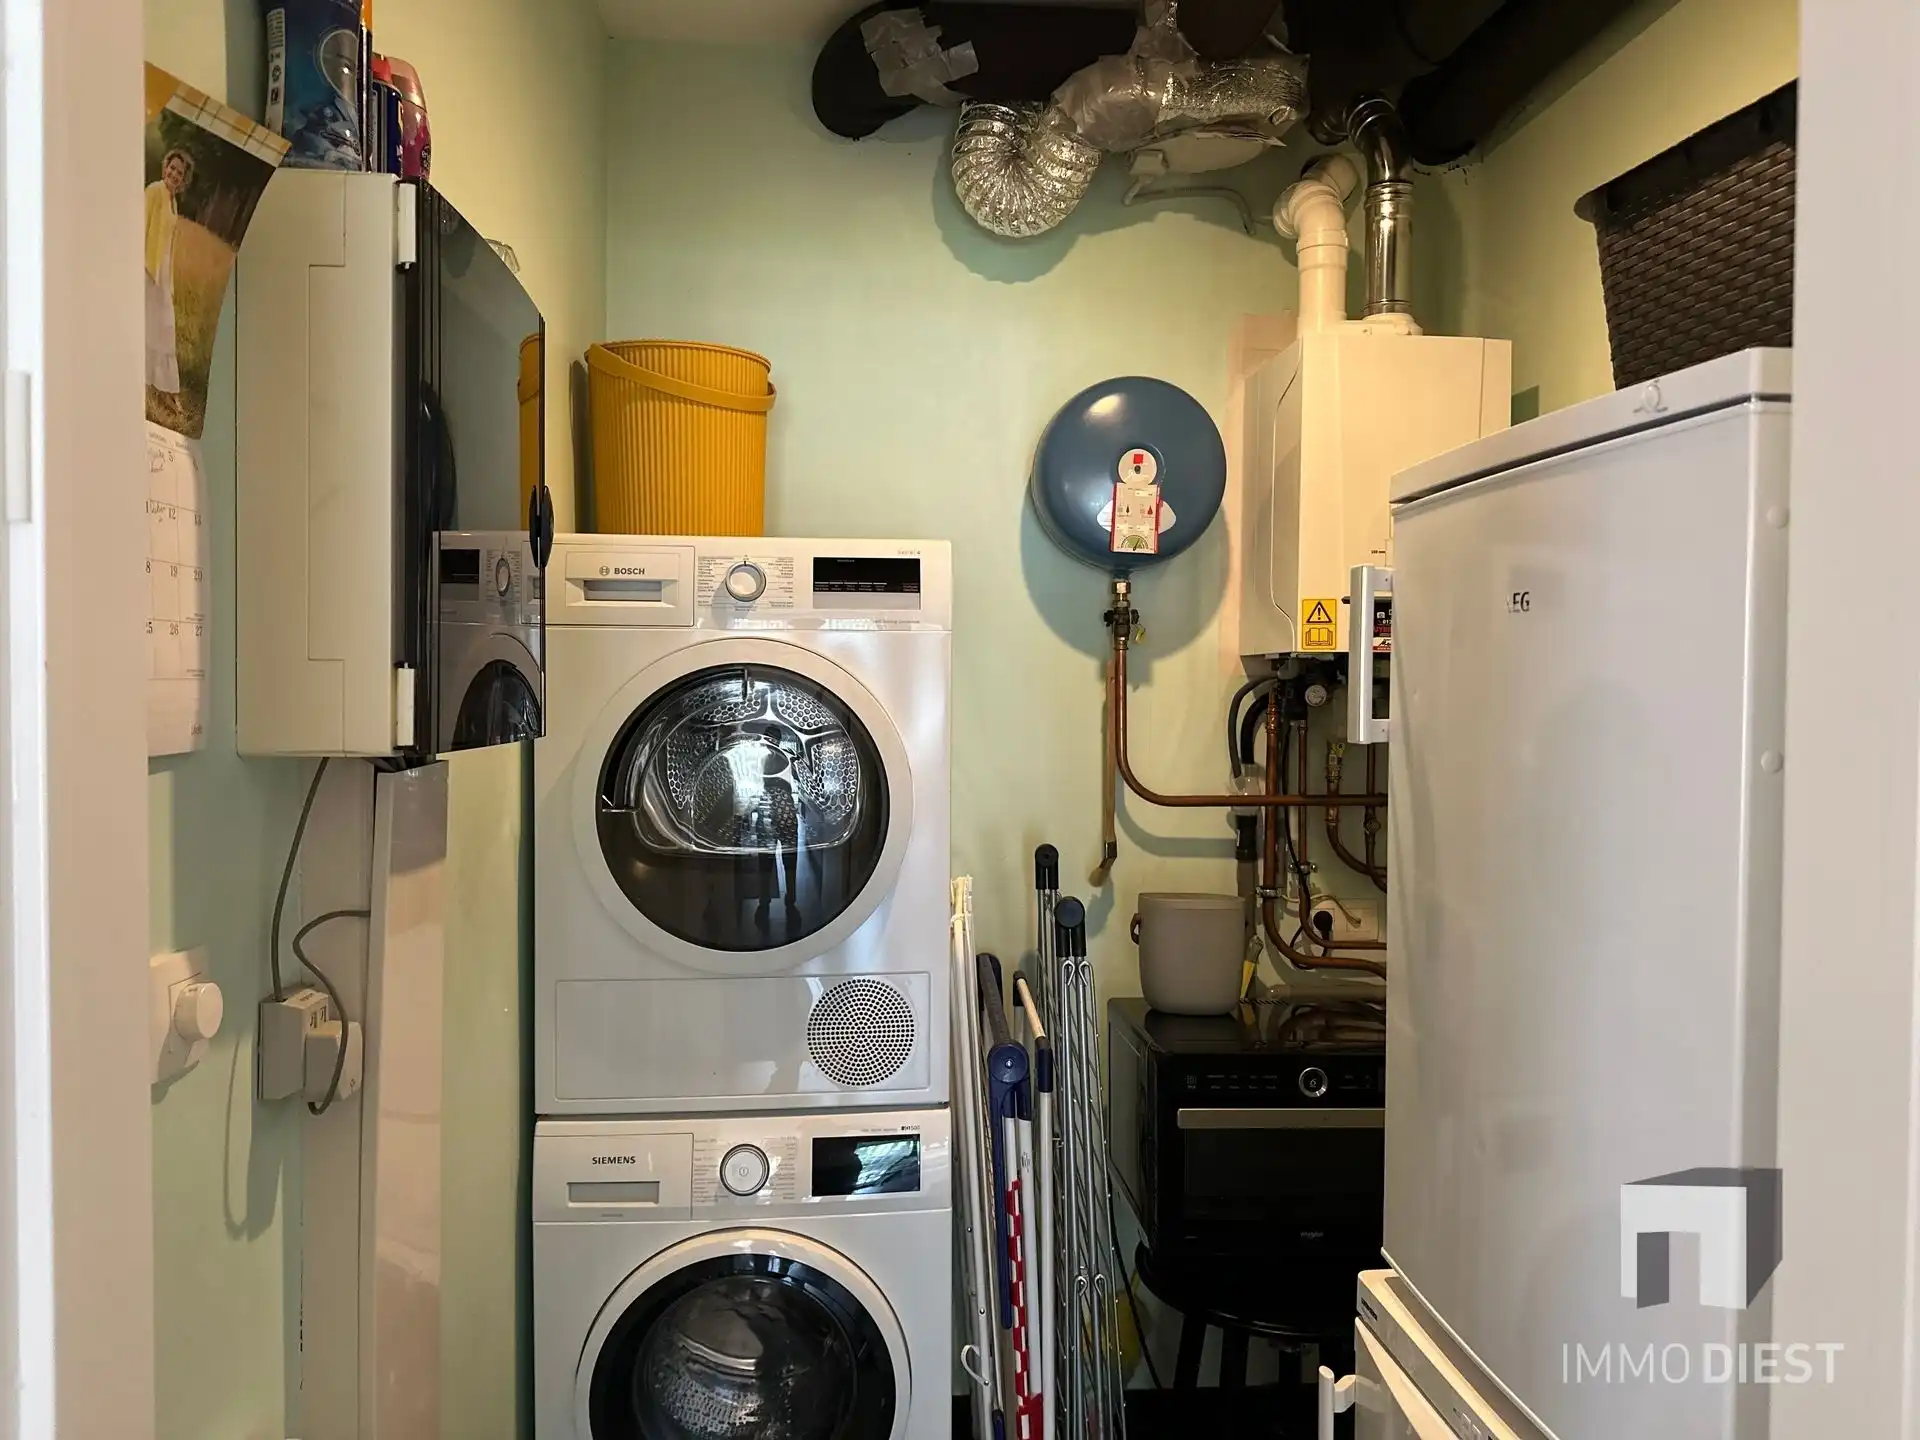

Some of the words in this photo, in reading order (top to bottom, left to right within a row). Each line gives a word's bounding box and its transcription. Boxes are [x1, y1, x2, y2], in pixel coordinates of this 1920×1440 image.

[168, 507, 176, 520] 12
[169, 565, 178, 578] 19
[193, 569, 203, 582] 20
[613, 567, 645, 575] BOSCH
[169, 623, 179, 636] 26
[195, 625, 203, 637] 27
[592, 1156, 636, 1165] SIEMENS
